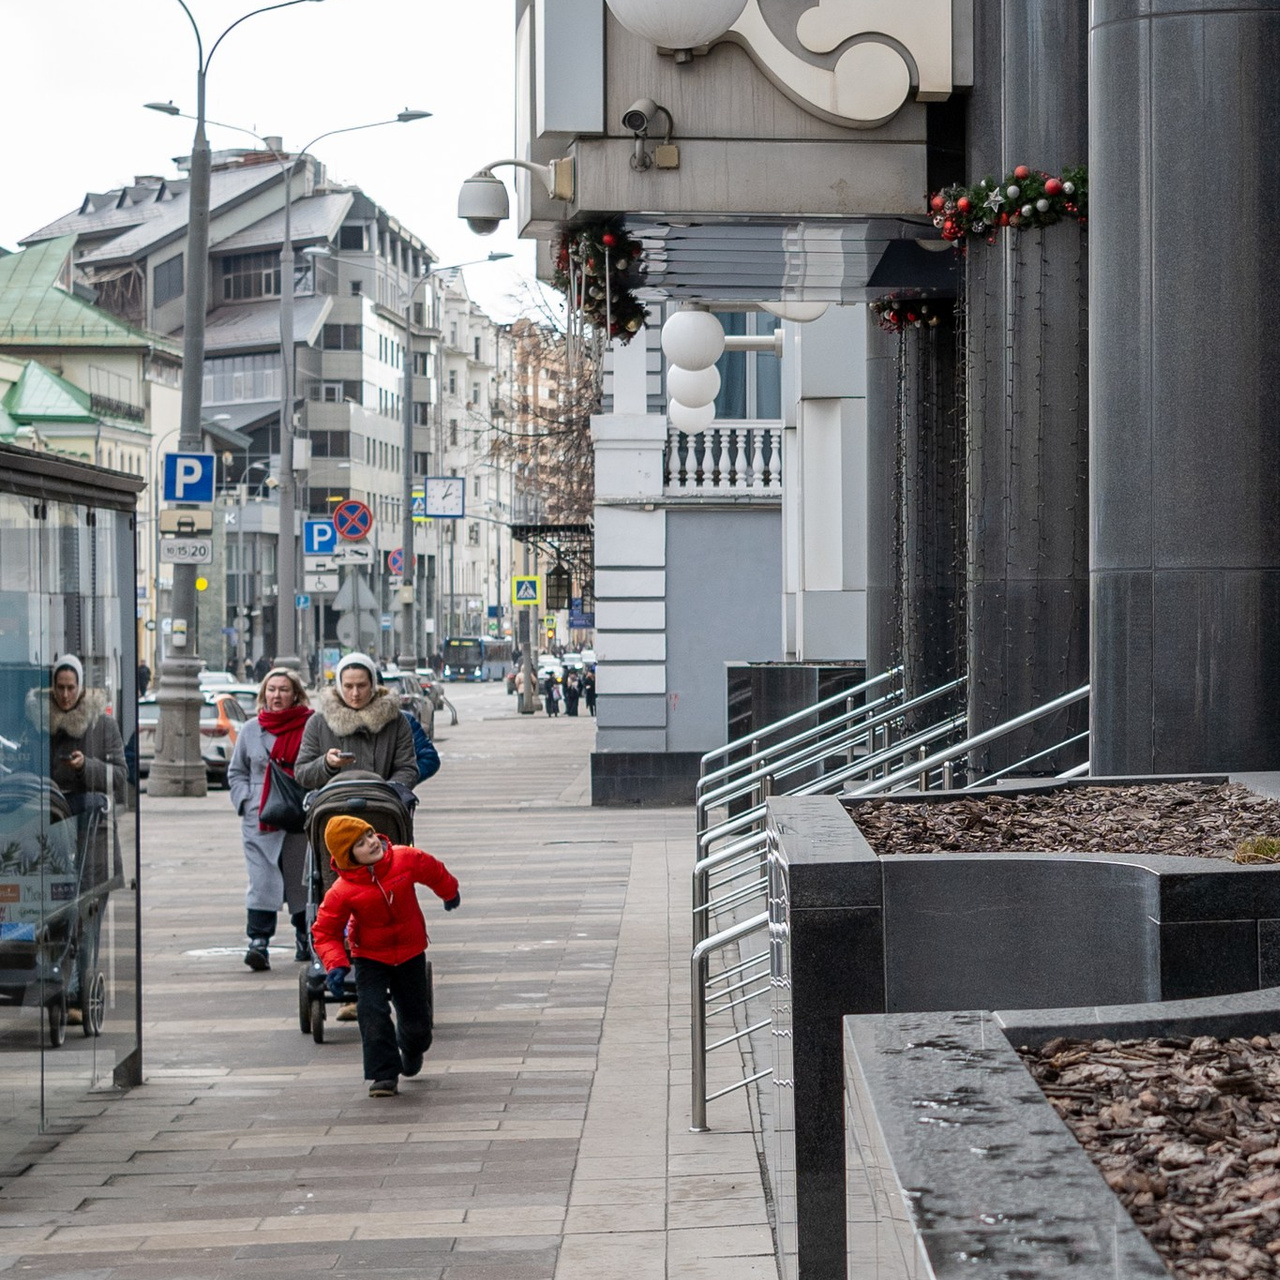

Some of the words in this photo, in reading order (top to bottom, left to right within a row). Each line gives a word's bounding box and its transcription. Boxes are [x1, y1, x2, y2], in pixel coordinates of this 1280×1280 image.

[175, 457, 203, 498] P
[166, 546, 175, 555] 10
[178, 546, 188, 556] 15
[191, 545, 207, 557] 20
[312, 523, 332, 551] P
